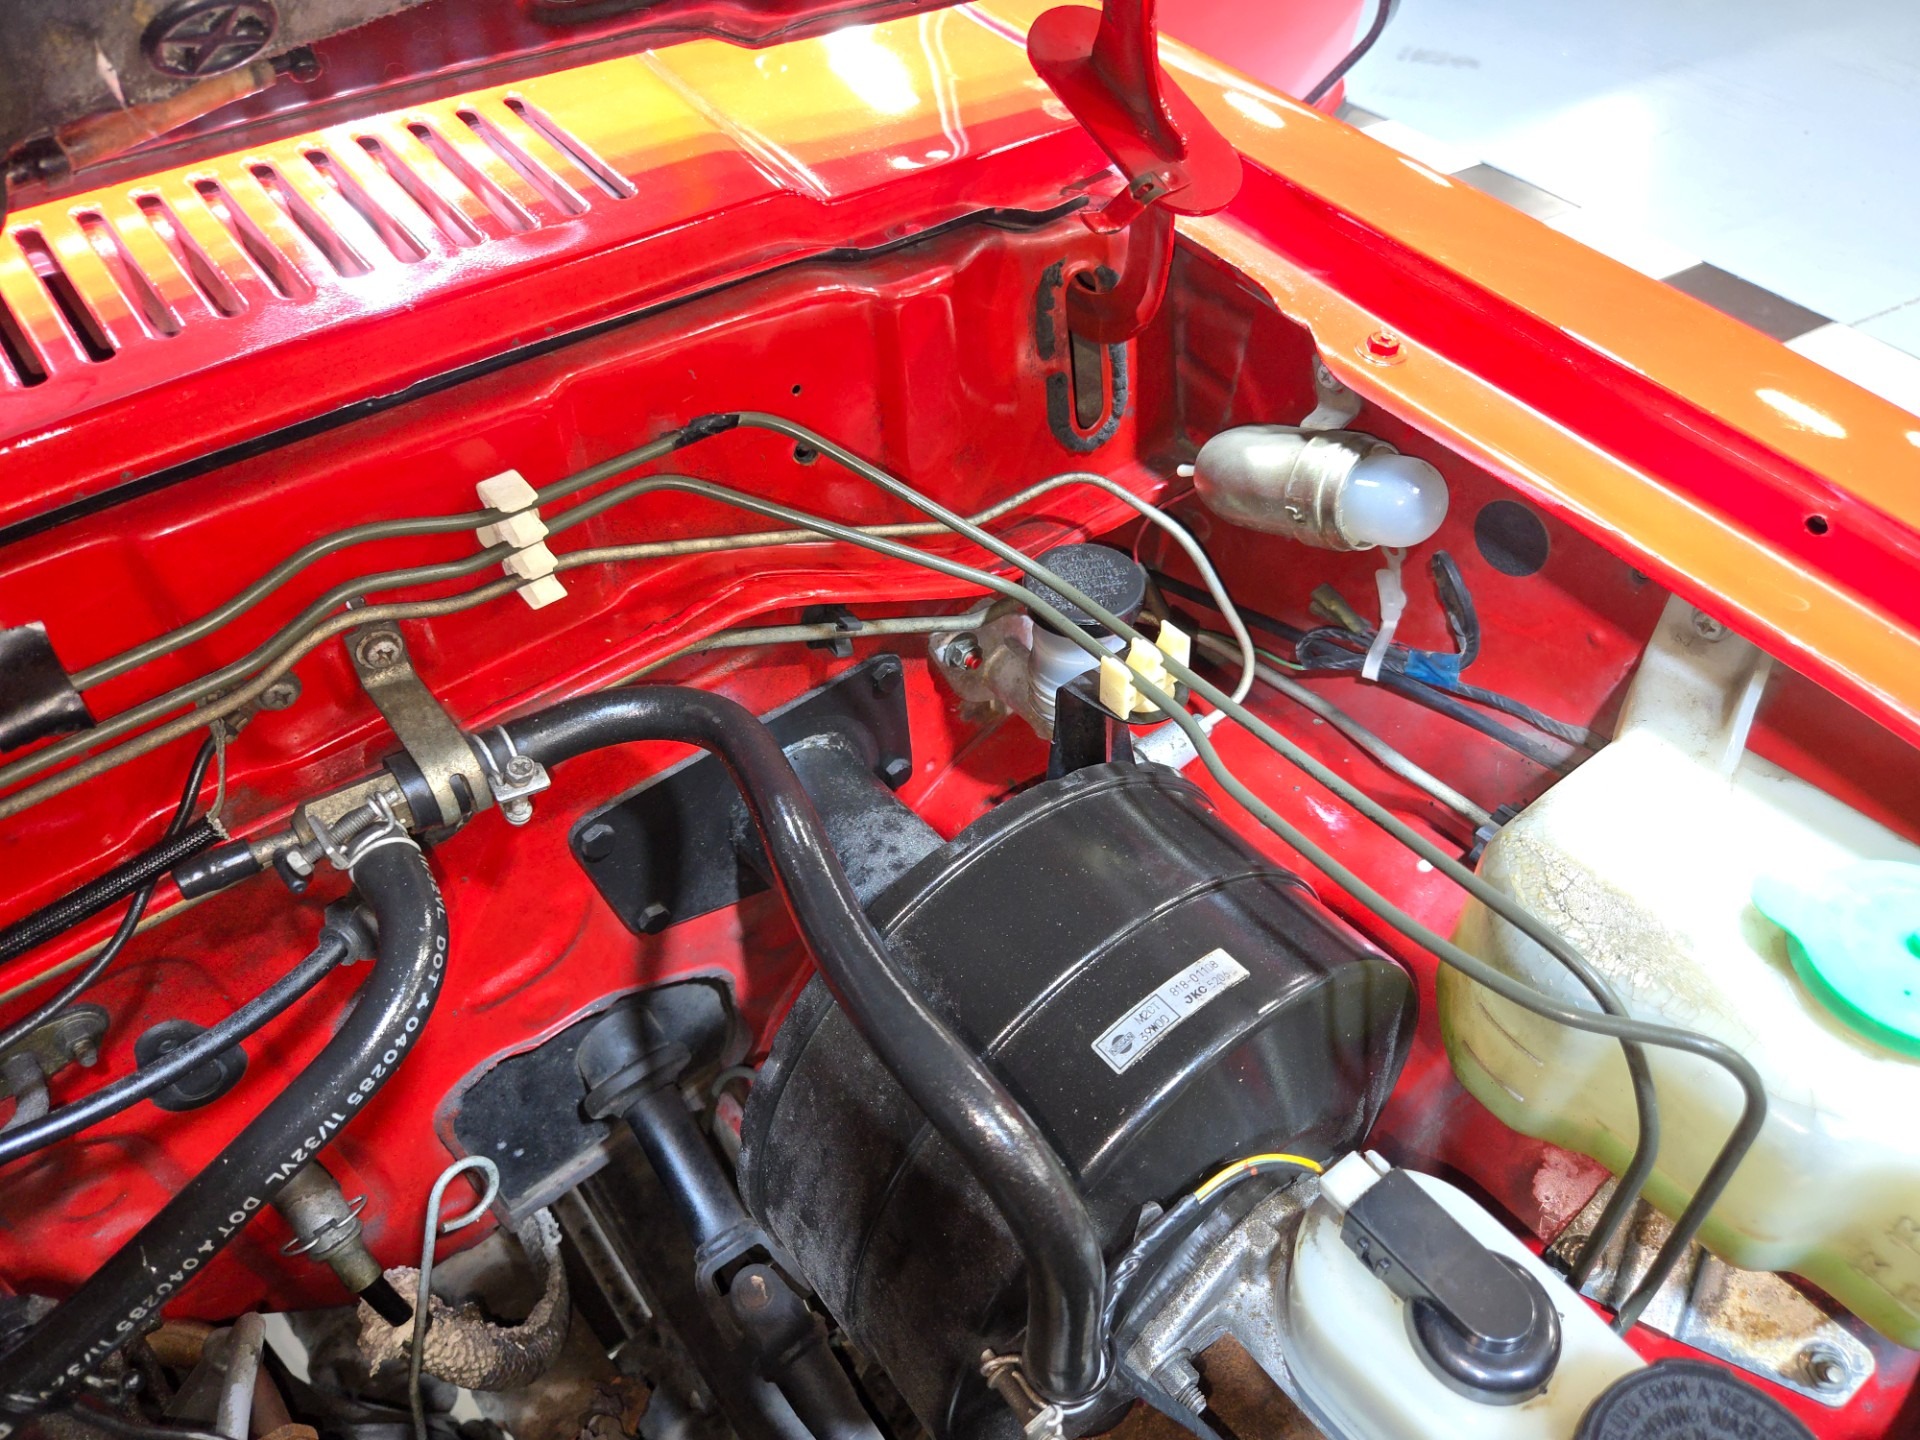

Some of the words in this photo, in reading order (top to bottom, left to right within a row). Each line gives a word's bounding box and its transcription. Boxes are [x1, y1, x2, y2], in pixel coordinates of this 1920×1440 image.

[427, 934, 447, 989] DOT
[1184, 985, 1208, 1004] JKC
[346, 1015, 420, 1107] 040285
[264, 1112, 347, 1186] 11/32VL
[218, 1195, 262, 1239] DOT
[115, 1257, 200, 1333] 040285
[1638, 1380, 1691, 1408] FROM
[1697, 1381, 1712, 1403] A
